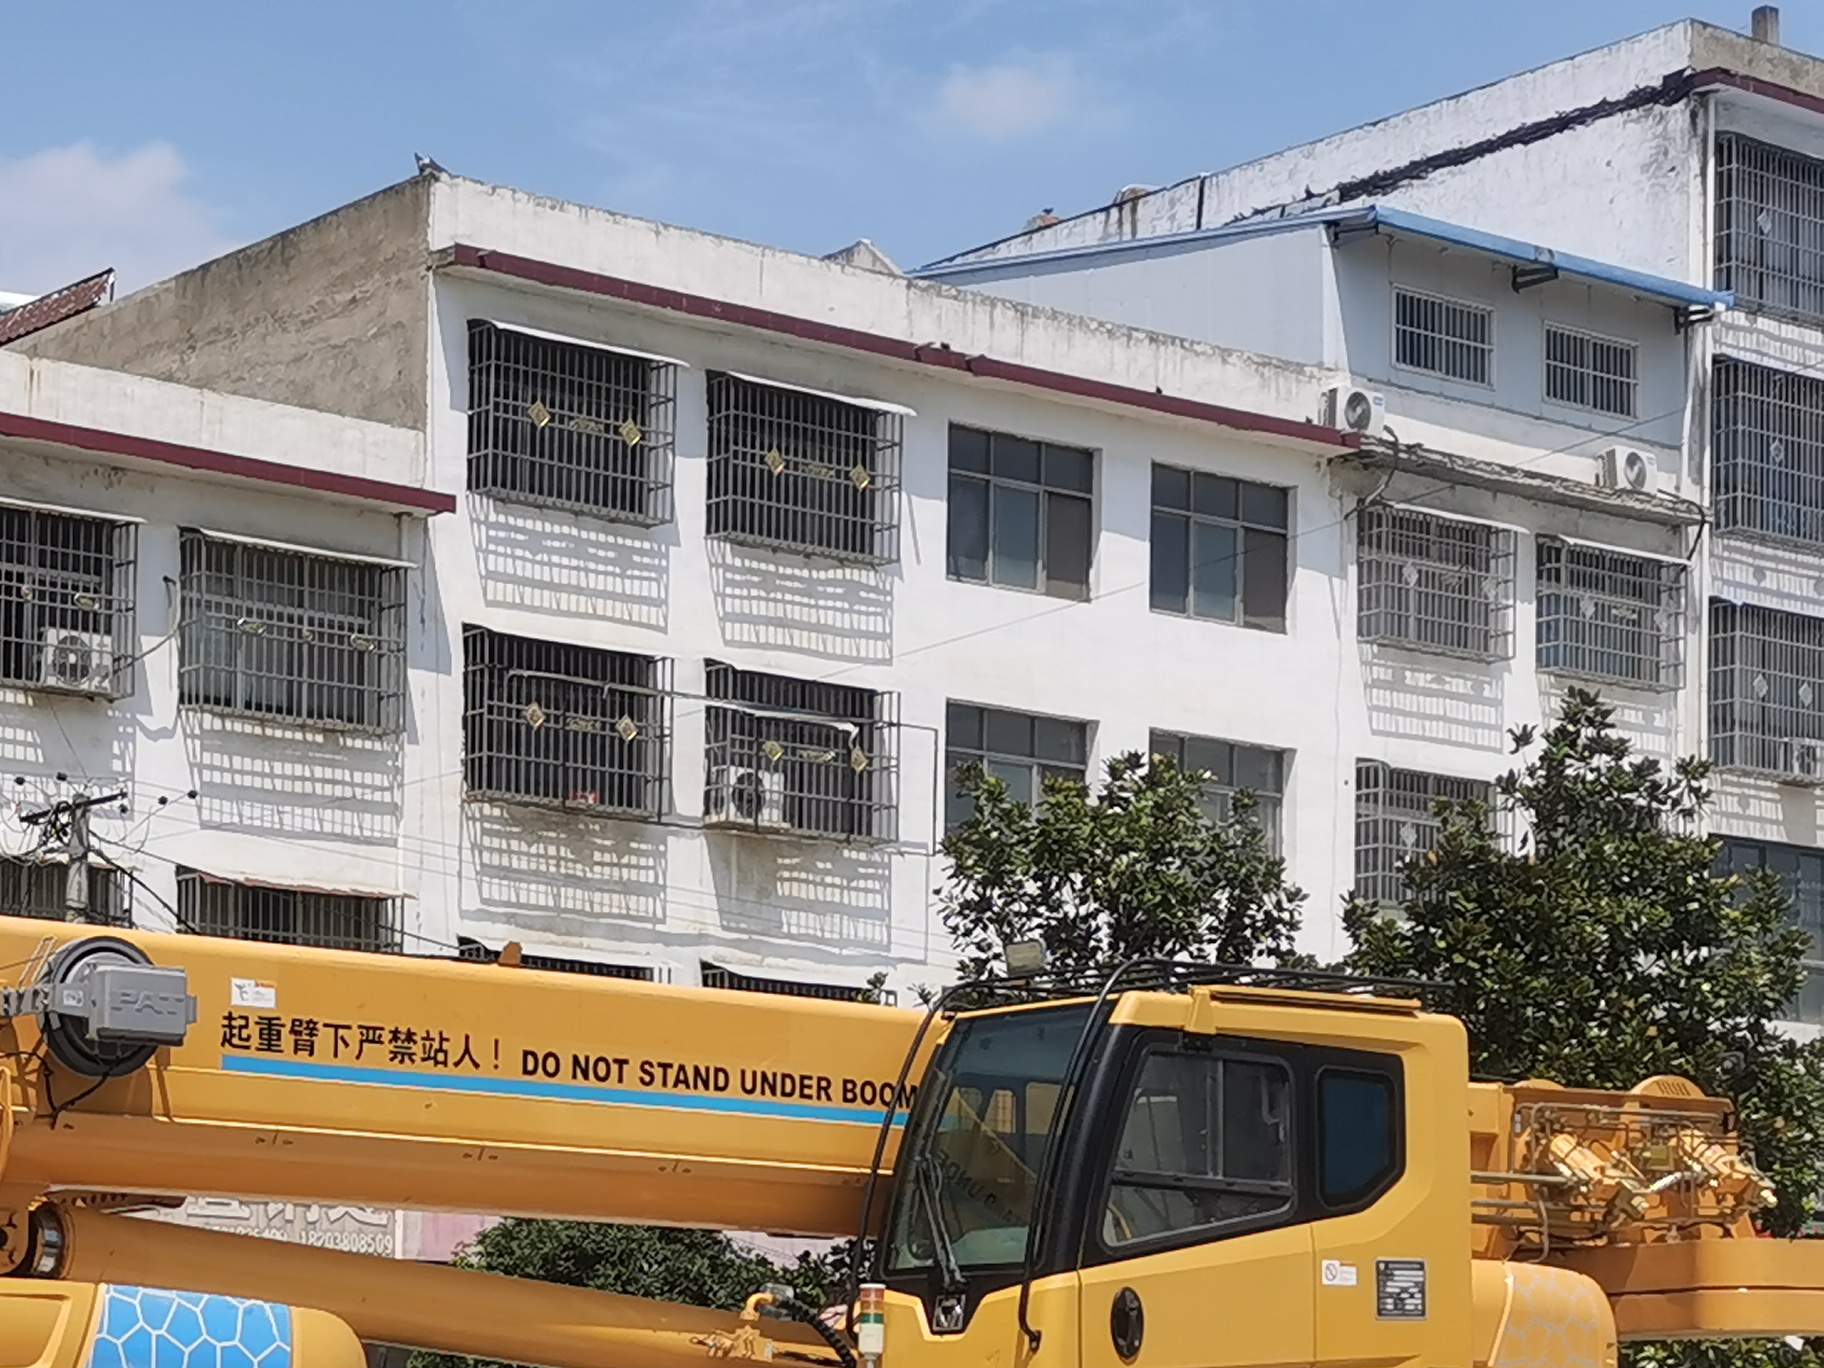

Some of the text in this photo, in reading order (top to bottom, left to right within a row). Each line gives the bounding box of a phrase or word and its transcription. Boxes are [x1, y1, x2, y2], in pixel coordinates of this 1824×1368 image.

[521, 1049, 919, 1109] DO NOT STAND UNDER BOOM
